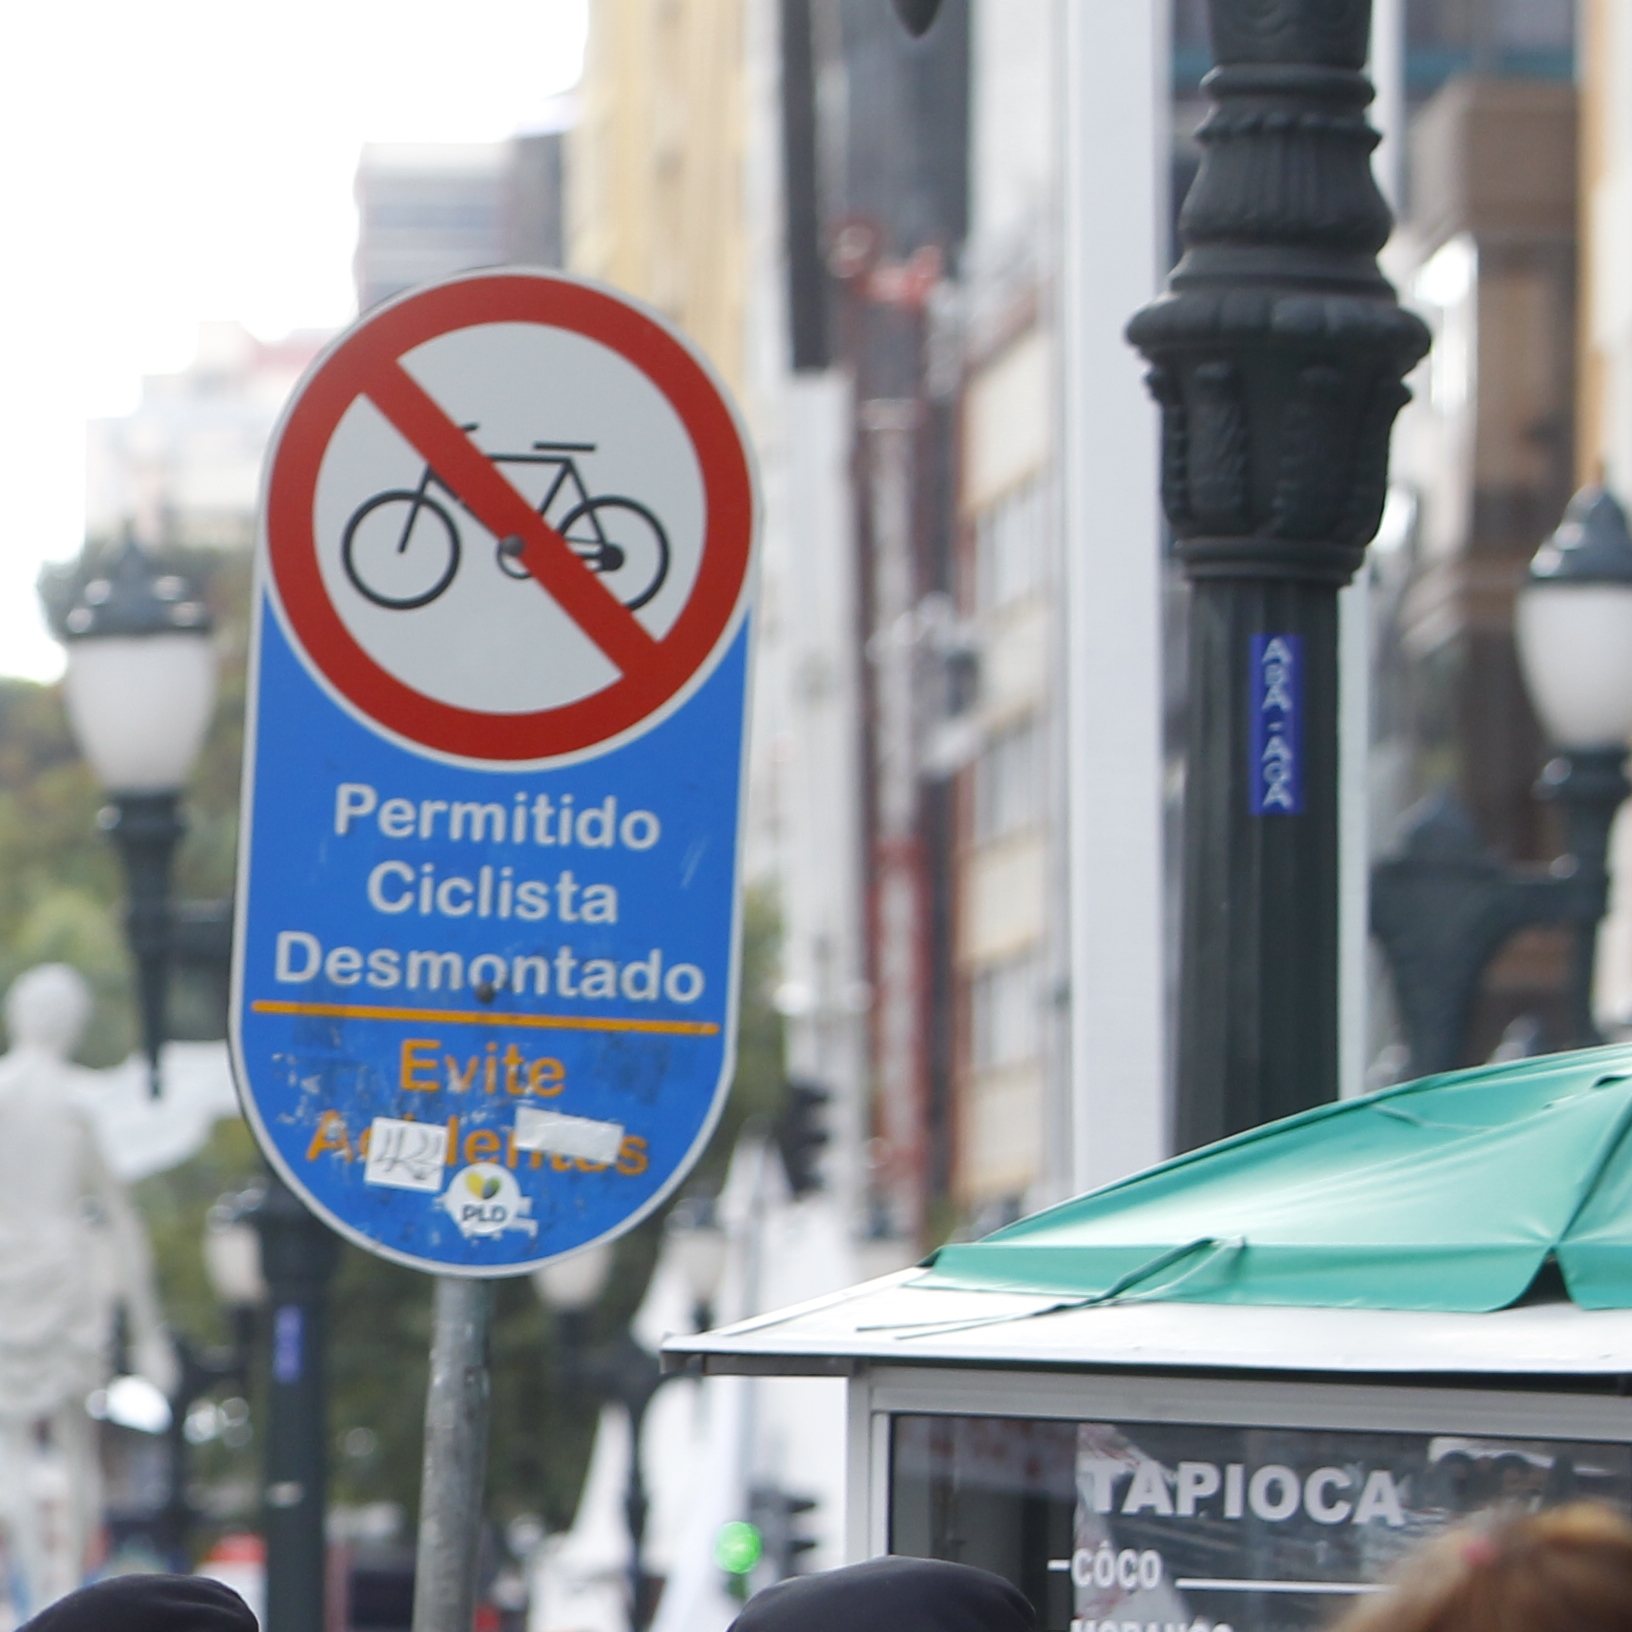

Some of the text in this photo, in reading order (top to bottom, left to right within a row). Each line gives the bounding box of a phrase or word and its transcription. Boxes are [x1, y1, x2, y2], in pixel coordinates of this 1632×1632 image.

[334, 783, 661, 850] Permitido
[367, 860, 619, 925] Ciclista
[274, 930, 706, 1003] Desmontado
[399, 1039, 566, 1097] Evite
[1077, 1459, 1406, 1527] TAPIOCA
